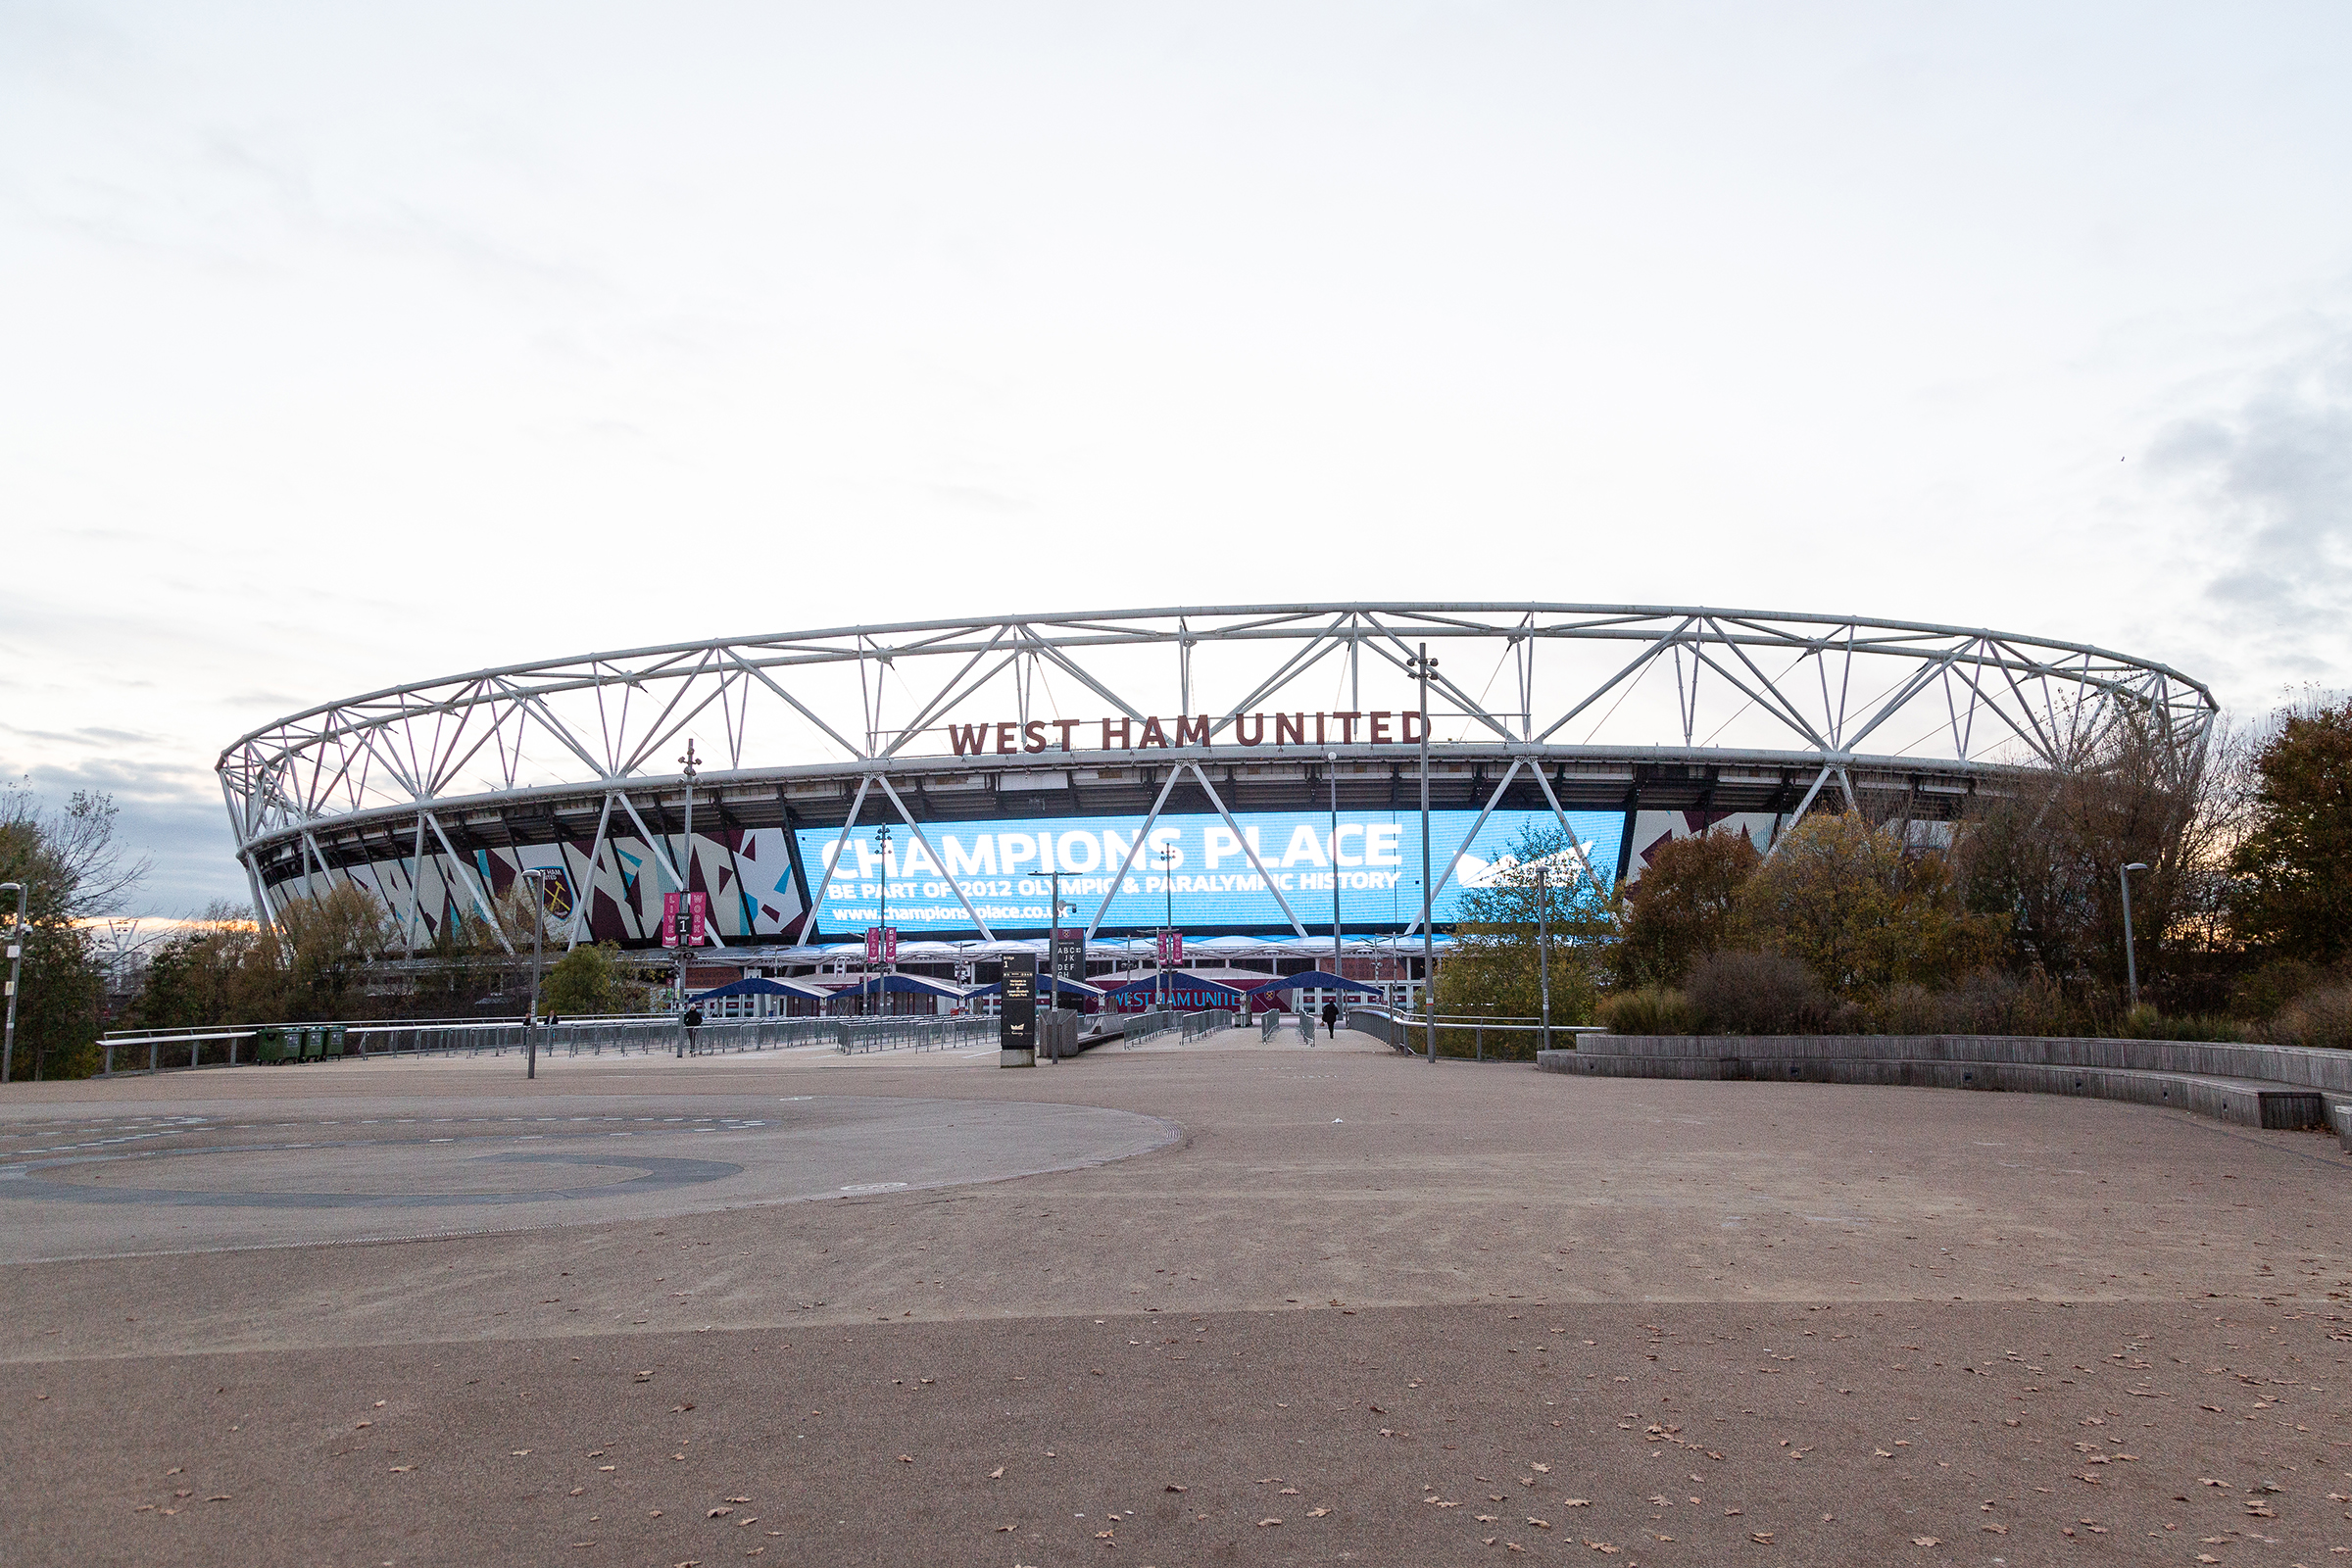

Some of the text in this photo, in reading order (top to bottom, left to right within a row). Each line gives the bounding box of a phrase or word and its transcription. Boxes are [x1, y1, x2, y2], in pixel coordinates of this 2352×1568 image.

[949, 710, 1432, 756] WEST HAM UNITED
[821, 823, 1402, 879] CHAMPIONS PLACE
[828, 871, 1402, 900] BE PART OF 2012 OLYMPIC & PARALYMPIC HISTORY
[679, 920, 687, 933] 1
[693, 895, 703, 933] WORK
[1194, 992, 1253, 1006] UNITE
